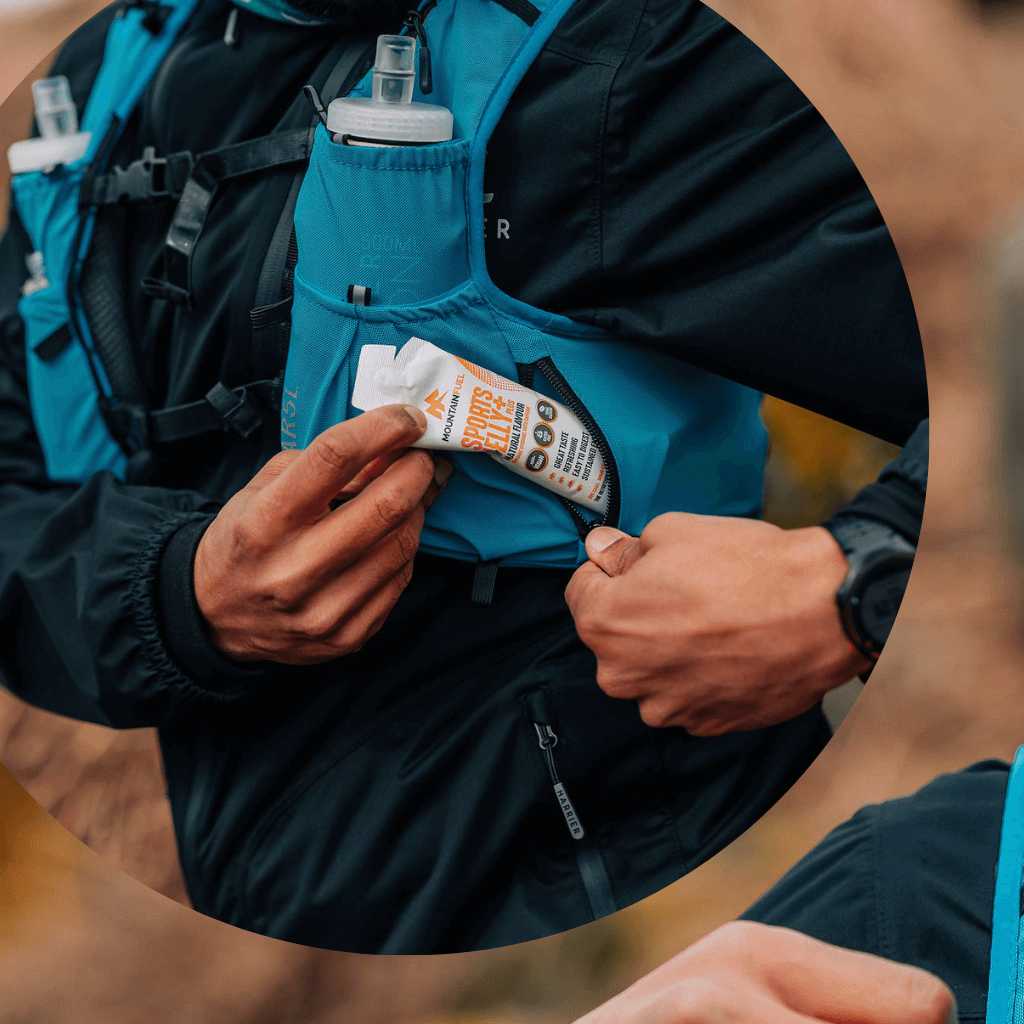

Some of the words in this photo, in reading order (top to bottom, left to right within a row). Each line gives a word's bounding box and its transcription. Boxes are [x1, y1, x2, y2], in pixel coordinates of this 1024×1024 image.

[461, 386, 493, 449] SPORTS
[482, 395, 513, 453] ELLY+
[504, 432, 520, 460] NATURAL
[512, 402, 525, 432] FLAVOUR
[553, 448, 564, 469] GREAT
[561, 431, 569, 449] TASTE
[563, 437, 579, 473] REFRESHING
[572, 459, 583, 477] EASY
[580, 431, 590, 453] DIGEST
[581, 447, 597, 481] SUSTAINED
[556, 789, 581, 835] HARRIER
